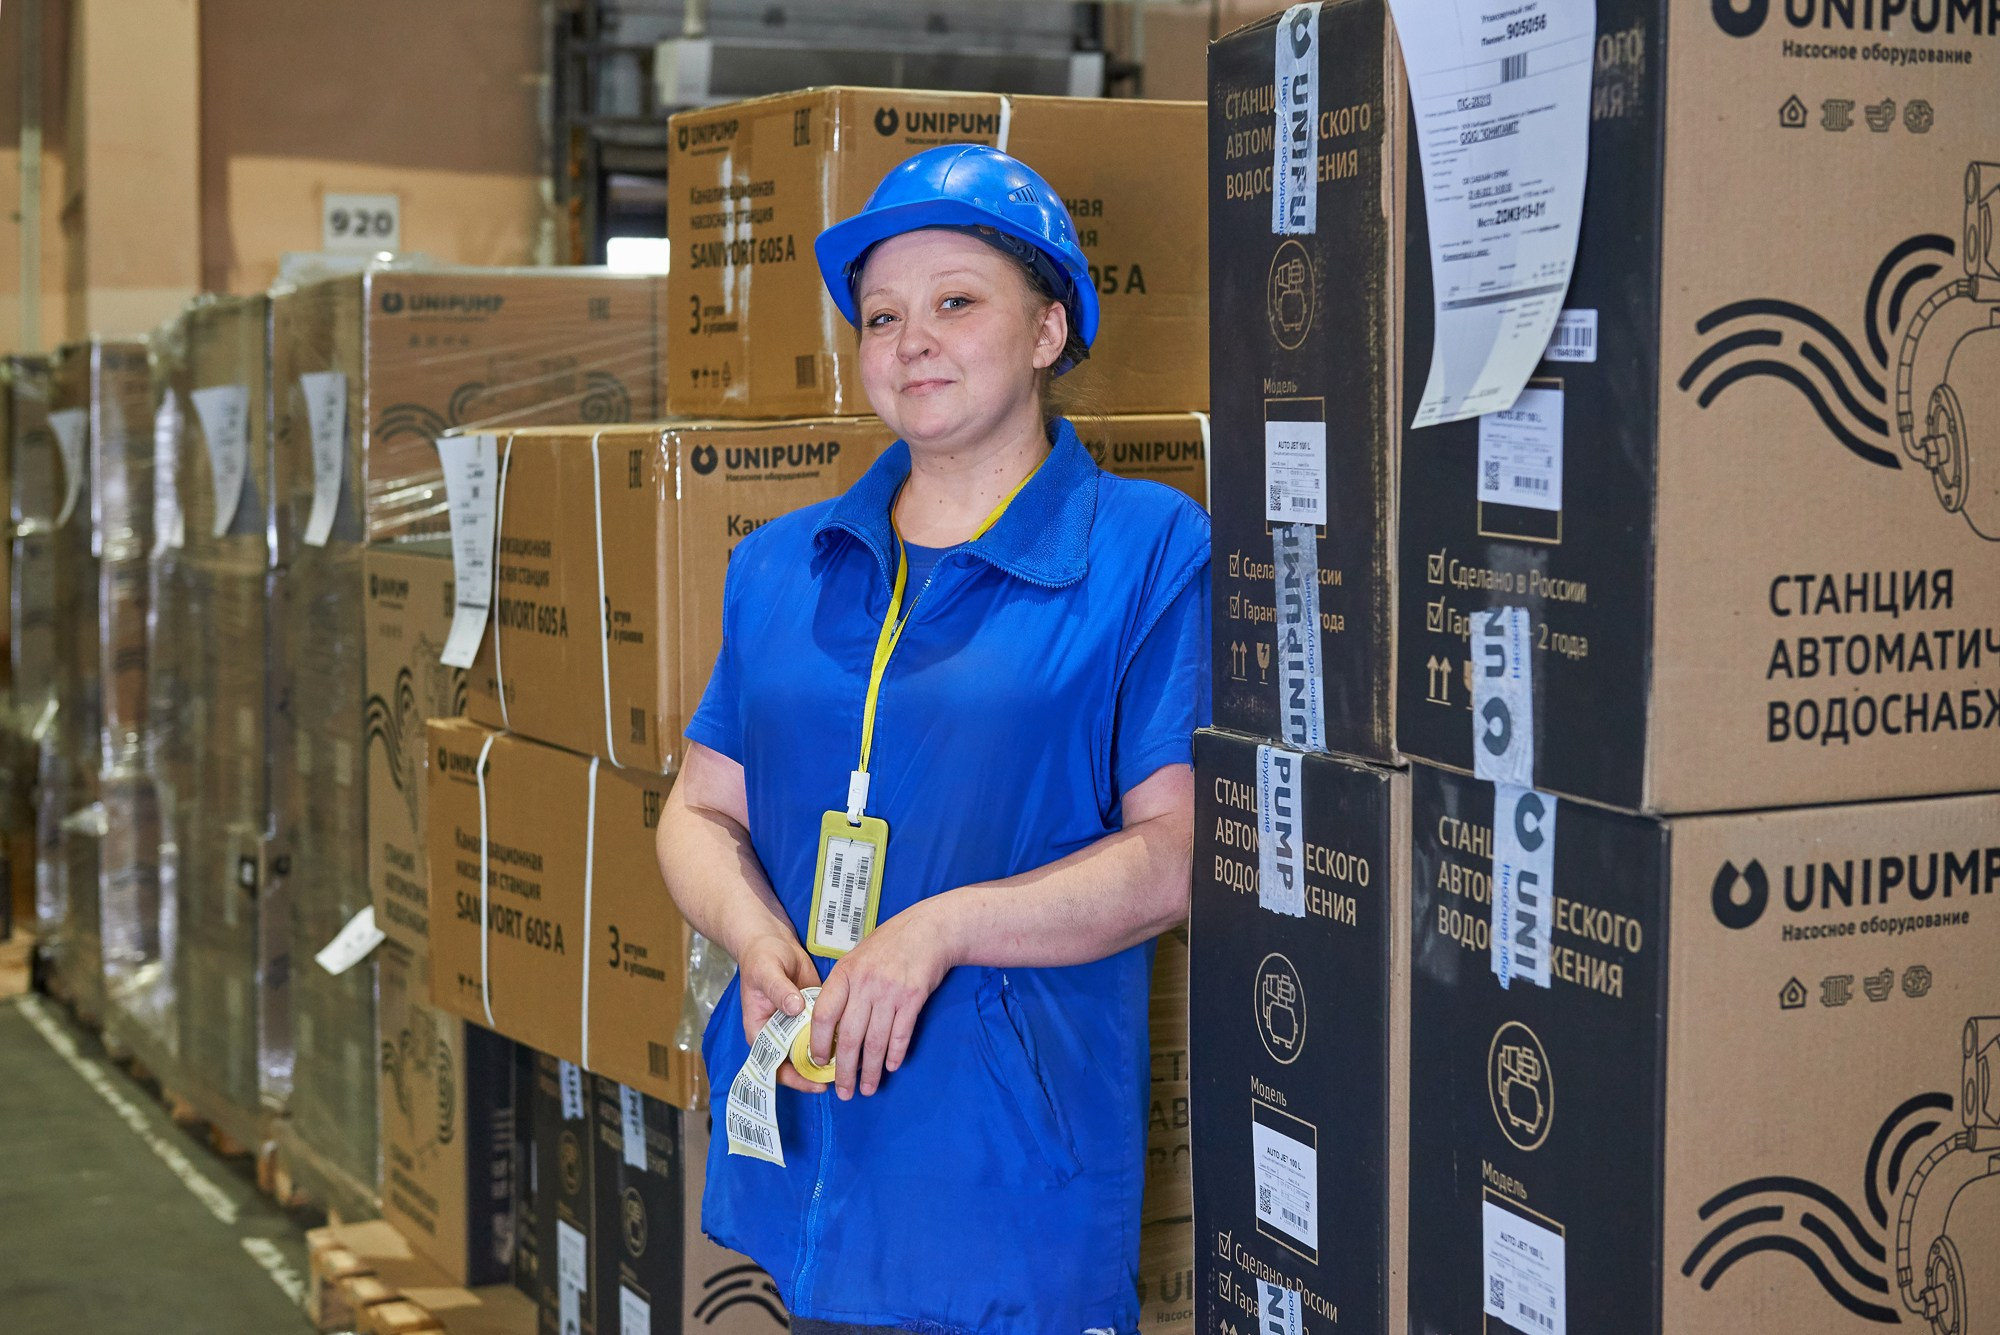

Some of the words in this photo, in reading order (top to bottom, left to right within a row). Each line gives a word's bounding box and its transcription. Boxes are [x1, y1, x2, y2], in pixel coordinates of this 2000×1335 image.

[1783, 40, 1857, 59] Насосное
[1862, 43, 1972, 66] оборудование
[691, 119, 739, 145] UNIPUMP
[329, 209, 394, 239] 920
[759, 236, 784, 263] 605
[690, 295, 701, 335] 3
[1263, 378, 1297, 395] Модель
[726, 442, 840, 470] UNIPUMP
[1243, 556, 1275, 581] Сдела
[1450, 559, 1513, 592] Сделано
[1516, 574, 1527, 594] в
[1529, 570, 1587, 604] России
[1769, 570, 1954, 619] СТАНЦИЯ
[1243, 598, 1277, 625] Гарант
[1537, 623, 1549, 650] 2
[1551, 632, 1588, 660] года
[1215, 777, 1258, 814] СТАНЦ
[1263, 747, 1271, 833] борудование
[1439, 815, 1494, 860] СТАНЦ
[525, 916, 552, 951] 605
[1782, 922, 1856, 942] Насосное
[1860, 911, 1969, 935] оборудование
[608, 925, 620, 969] 3
[1250, 1075, 1287, 1107] Модель
[754, 1122, 771, 1136] CNT
[1482, 1159, 1527, 1200] Модель
[1235, 1243, 1283, 1287] Сделано
